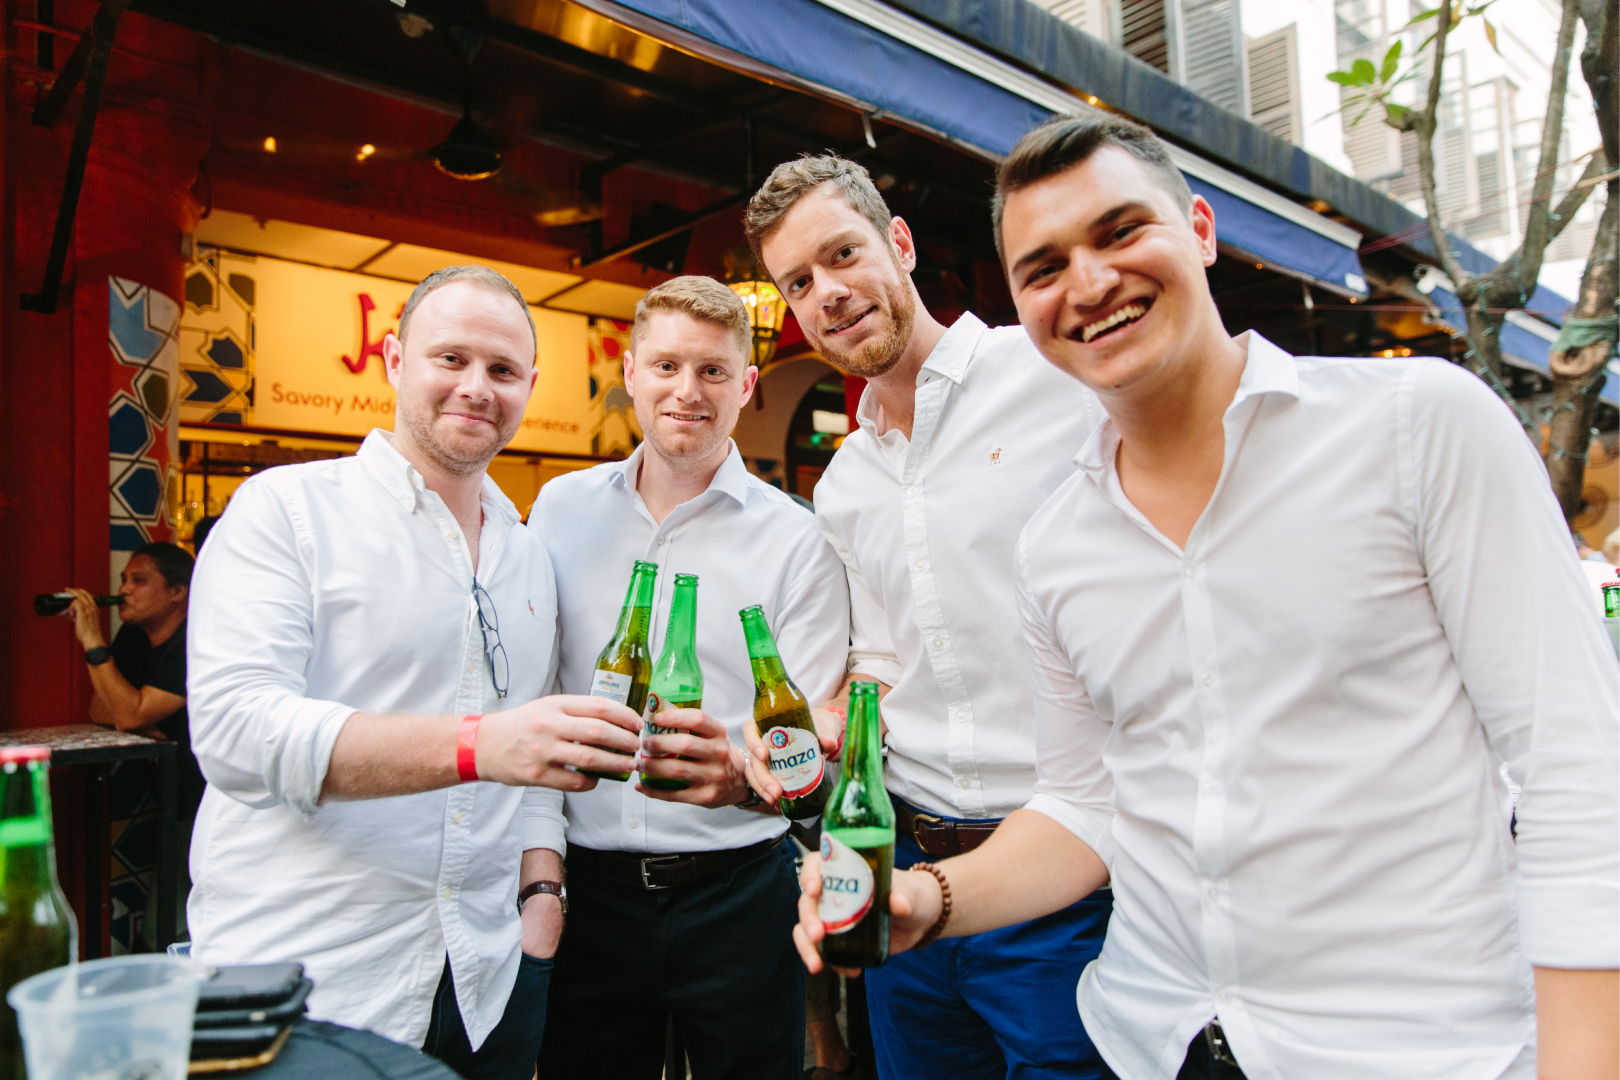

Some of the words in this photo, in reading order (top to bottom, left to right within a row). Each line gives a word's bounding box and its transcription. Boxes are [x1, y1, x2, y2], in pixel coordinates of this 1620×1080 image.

[271, 382, 344, 416] Savory
[350, 393, 396, 415] Mid
[643, 719, 678, 735] maza
[768, 747, 816, 771] lmaza
[822, 875, 858, 893] aza
